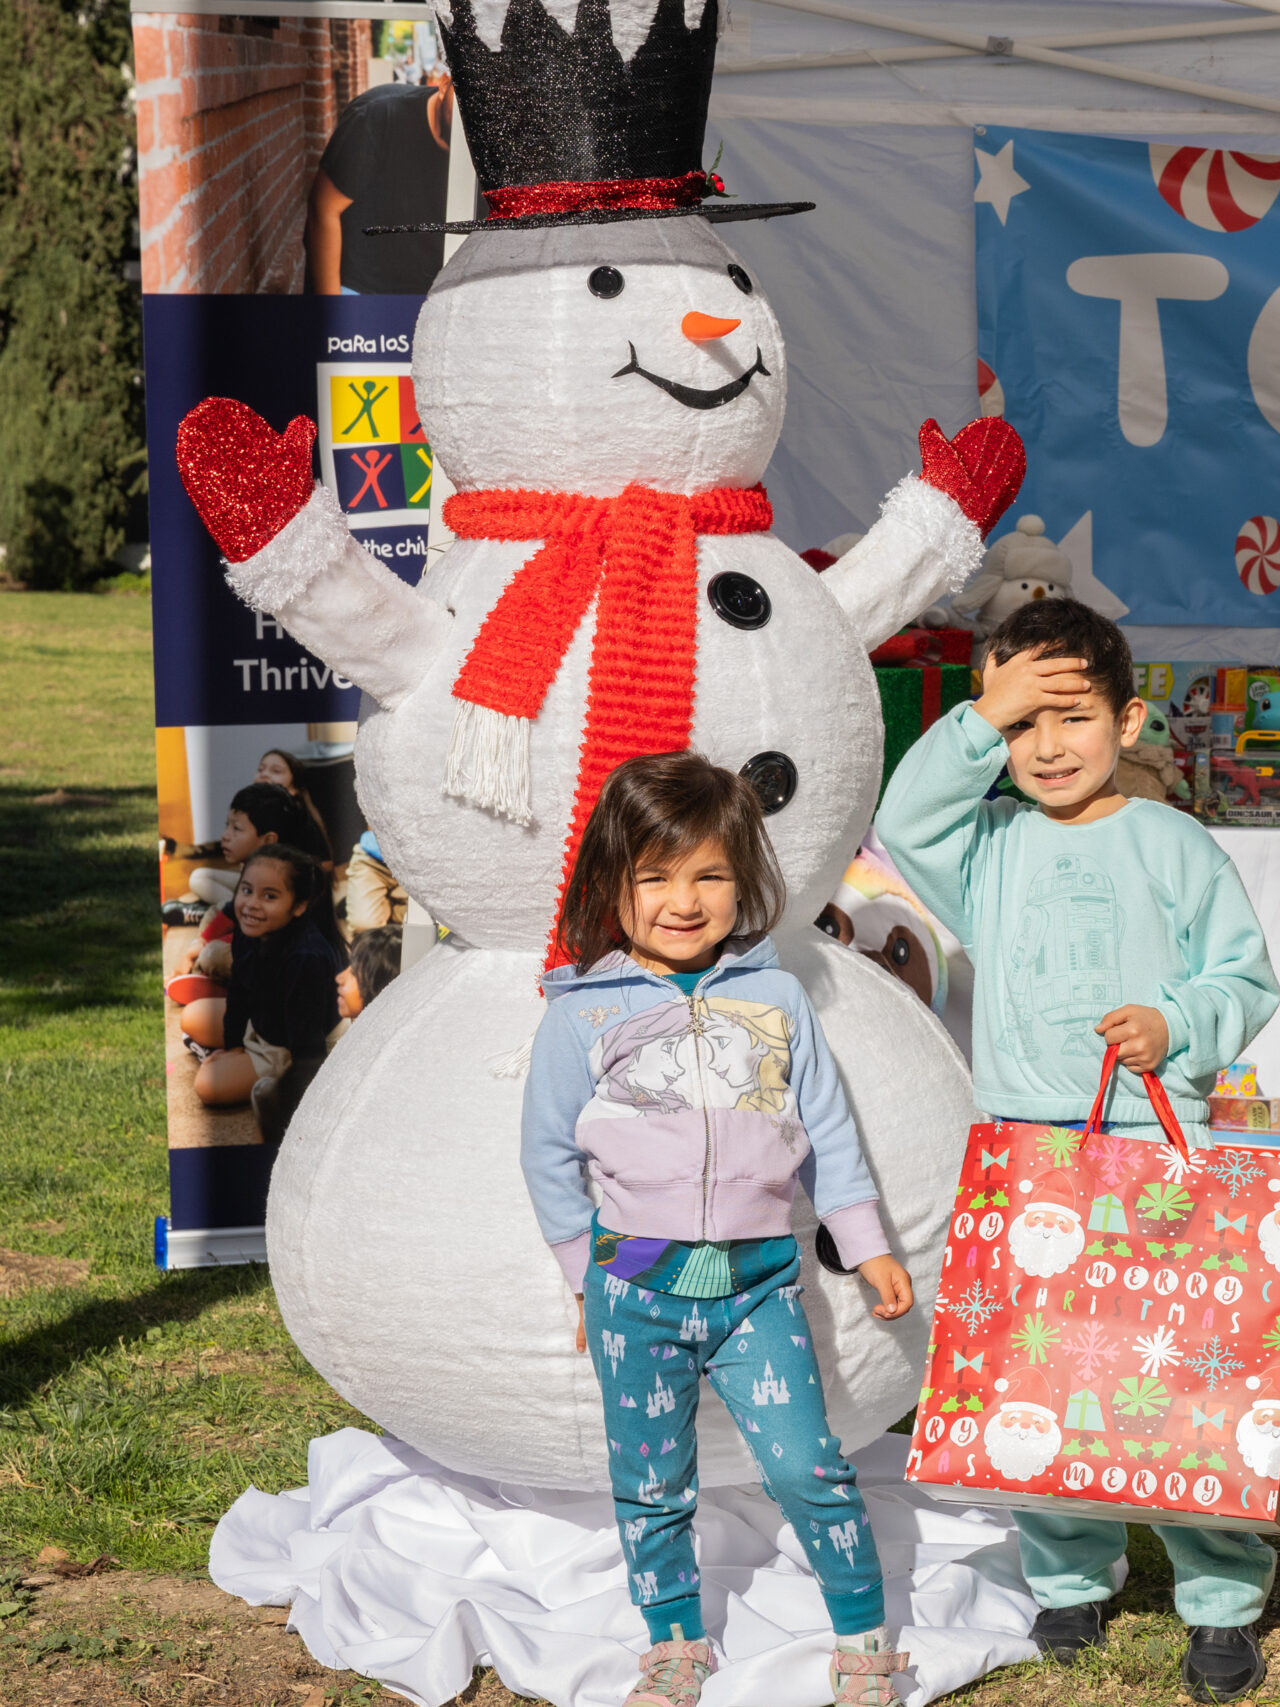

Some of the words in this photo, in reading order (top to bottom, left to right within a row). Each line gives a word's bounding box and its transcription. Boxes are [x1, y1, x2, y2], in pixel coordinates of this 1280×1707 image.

[1086, 1262, 1242, 1304] MERRY
[1011, 1284, 1241, 1334] CHRISTMAS
[1063, 1463, 1221, 1504] MERRY
